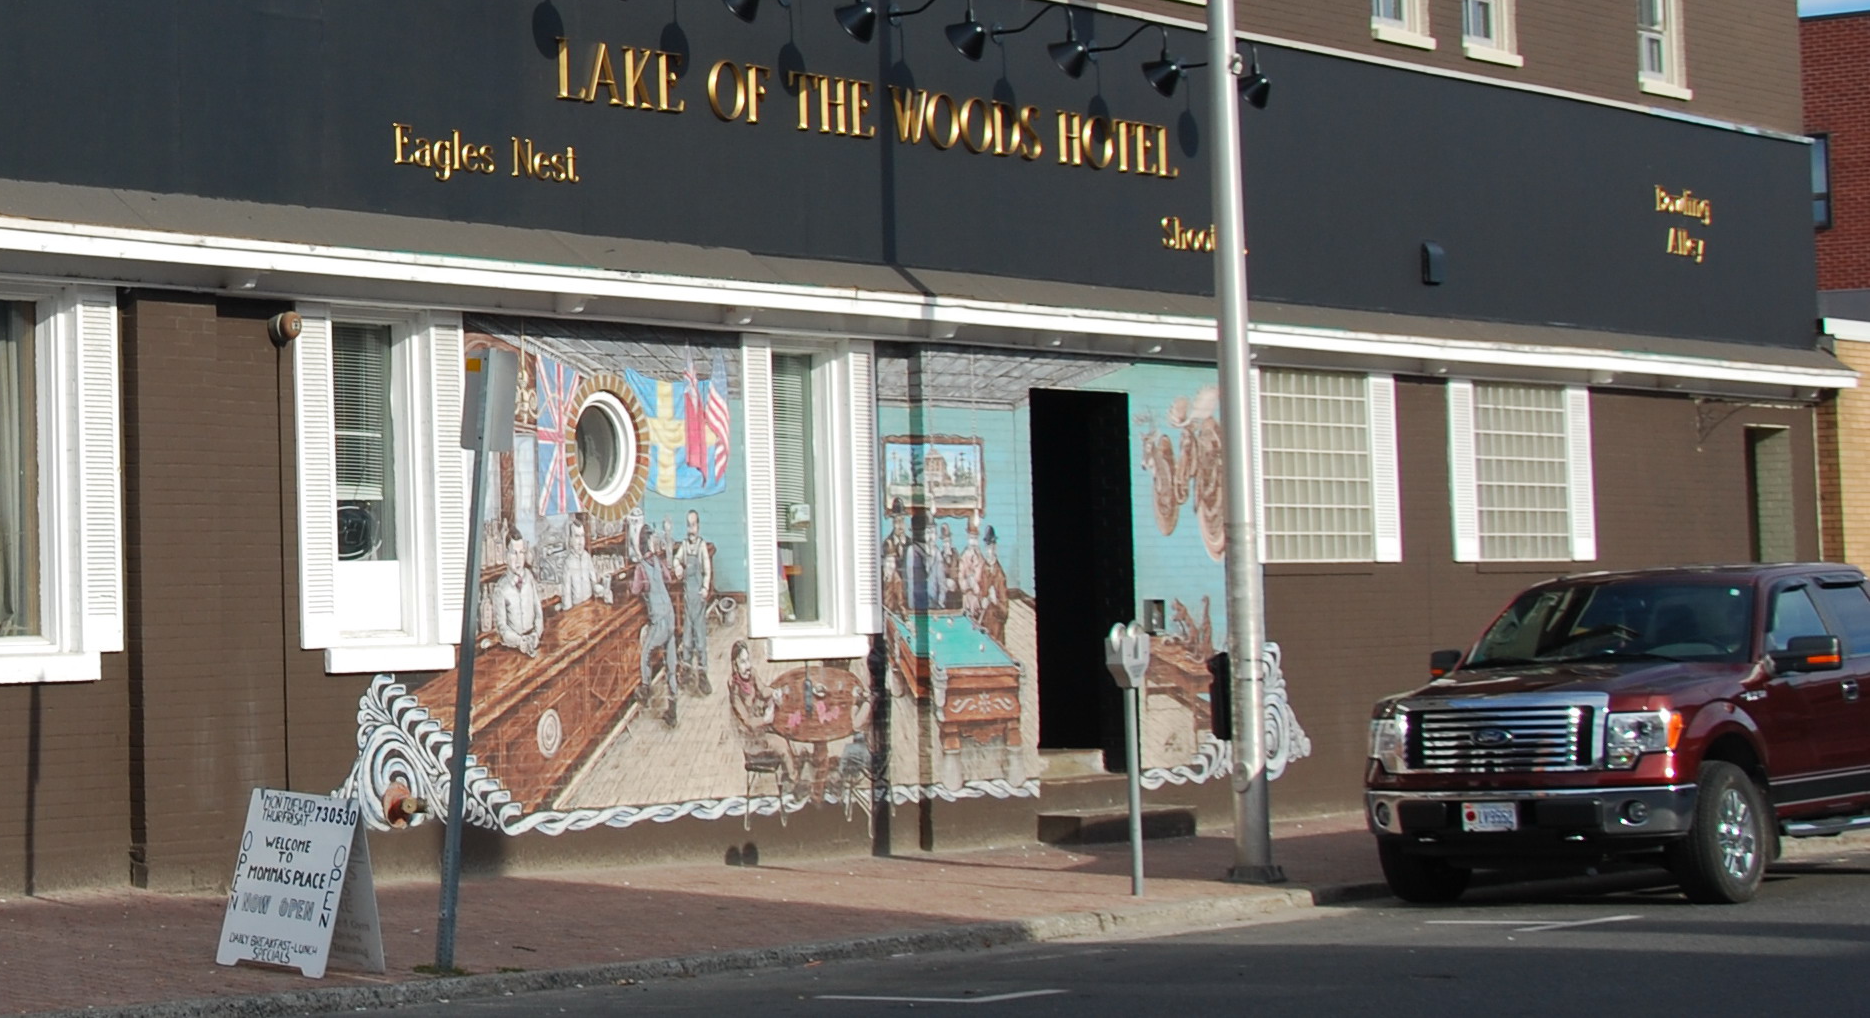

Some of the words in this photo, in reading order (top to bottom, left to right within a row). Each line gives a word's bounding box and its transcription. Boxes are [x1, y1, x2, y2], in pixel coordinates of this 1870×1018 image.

[554, 36, 684, 113] LAKE
[707, 59, 771, 124] OF
[787, 70, 876, 139] THE
[888, 84, 1042, 160] WOODS
[1056, 109, 1179, 178] HOTEL
[392, 123, 494, 181] Eagles
[512, 136, 579, 183] Nest
[265, 836, 312, 853] WELCOME
[278, 851, 293, 863] TO
[292, 870, 327, 889] PLACE
[241, 892, 272, 915] NOW
[279, 897, 315, 921] OPEN
